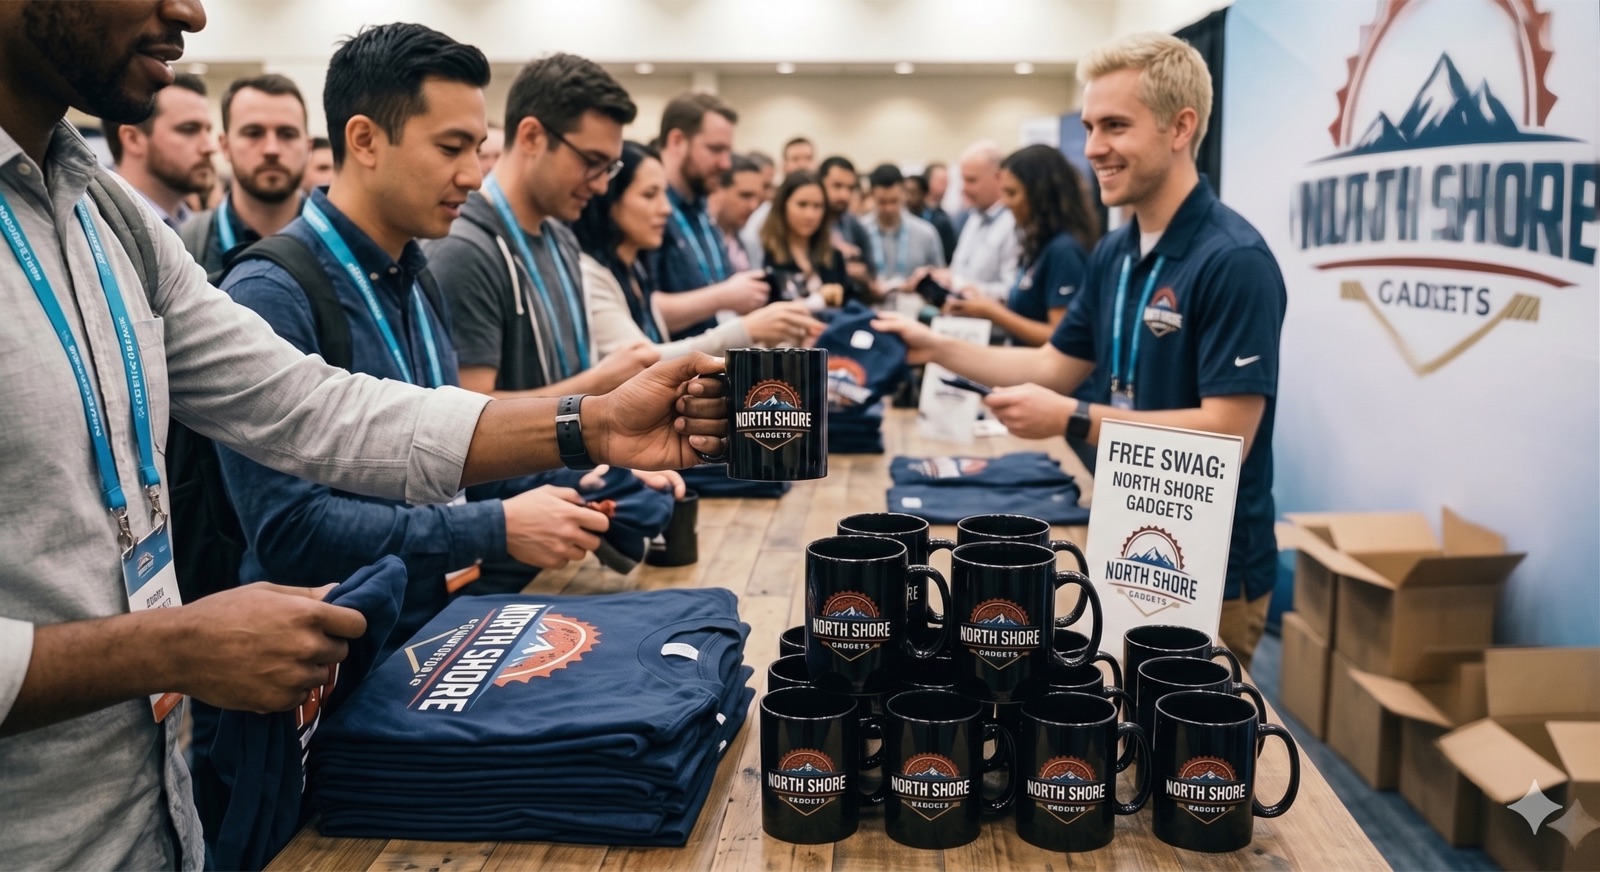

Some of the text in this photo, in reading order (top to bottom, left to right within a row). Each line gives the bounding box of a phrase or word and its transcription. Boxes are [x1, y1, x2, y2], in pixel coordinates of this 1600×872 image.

[1431, 161, 1600, 267] SHORE
[735, 410, 812, 428] NORTH SHORE
[755, 431, 792, 439] GADGETS
[1108, 440, 1226, 480] FREE SWAG:
[1112, 471, 1215, 503] NORTH SHORE
[1126, 494, 1193, 521] GADGETS
[1105, 560, 1198, 601] NORTH SHORE
[1128, 590, 1168, 606] GADGETS
[473, 603, 548, 647] NORTH
[812, 617, 891, 638] NORTH SHORE
[960, 625, 1040, 645] NORTH SHORE
[831, 641, 871, 650] GADGETS
[417, 648, 506, 713] SHORE
[768, 771, 847, 793] NORTH SHORE
[891, 775, 971, 798] NORTH SHORE
[1026, 779, 1107, 801] NORTH SHORE
[1165, 779, 1247, 801] NORTH SHORE
